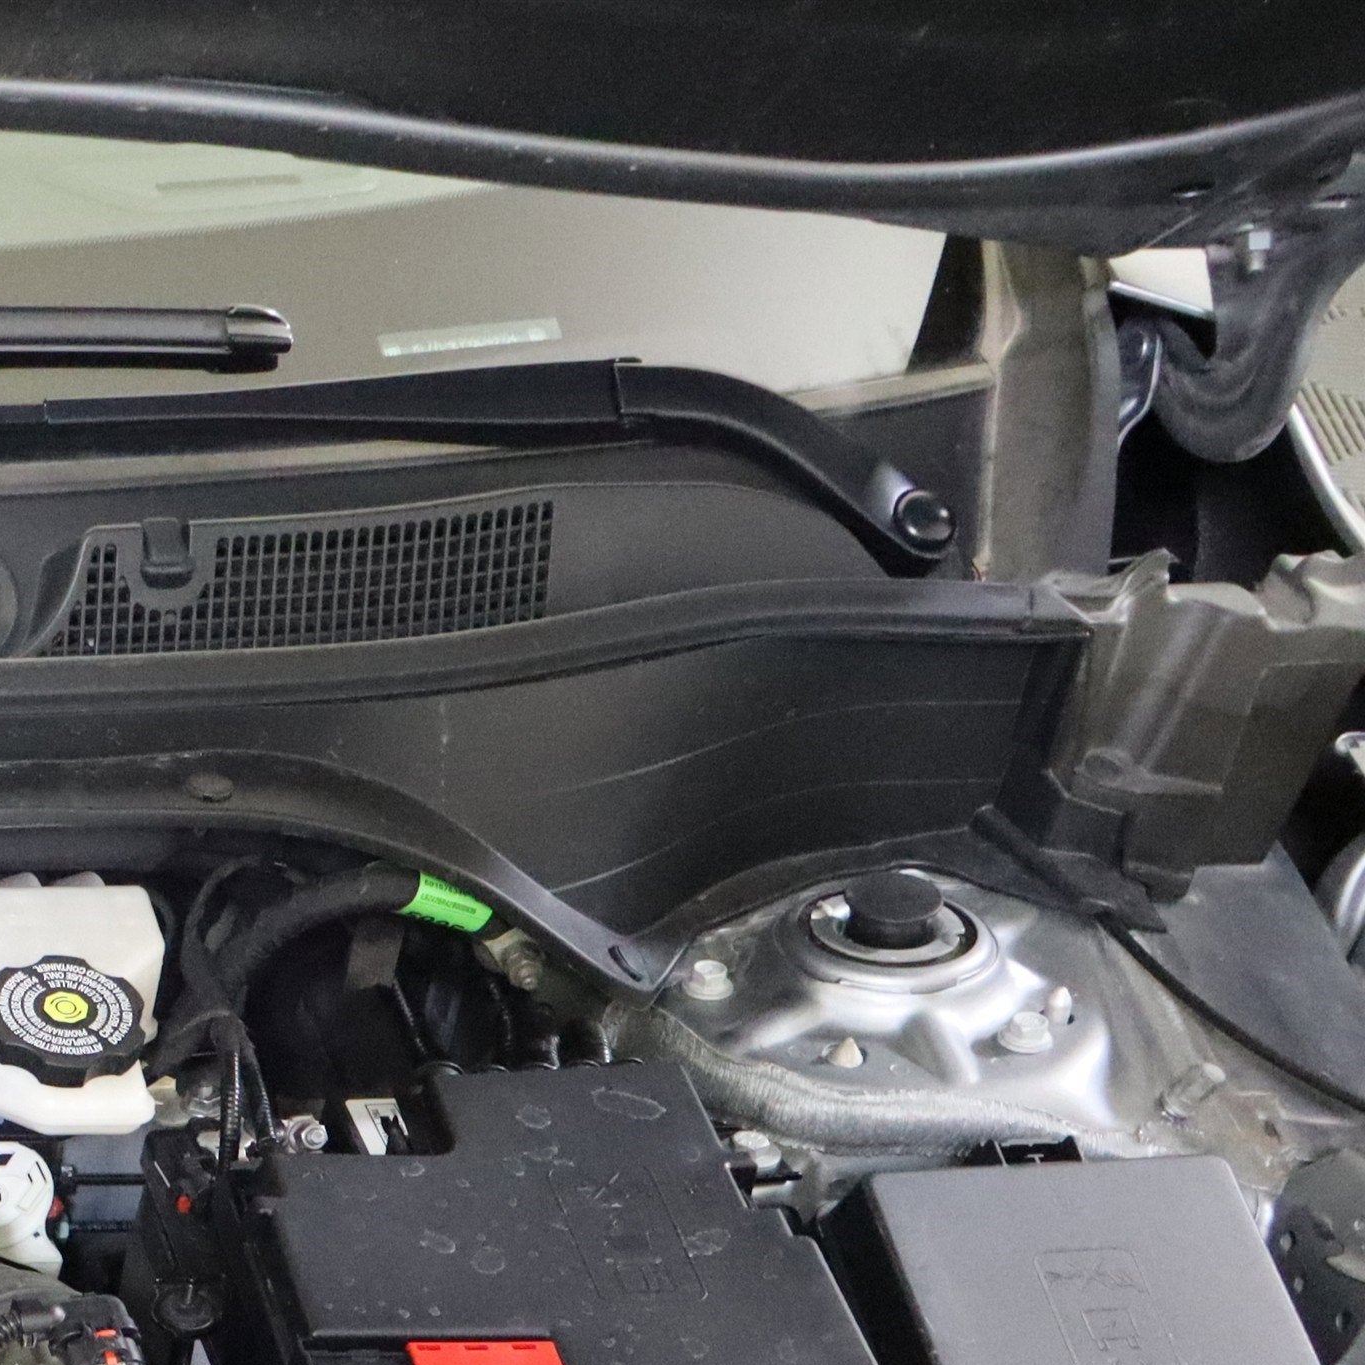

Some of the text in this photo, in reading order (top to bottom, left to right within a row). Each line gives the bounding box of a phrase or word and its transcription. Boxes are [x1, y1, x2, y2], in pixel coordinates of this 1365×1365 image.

[40, 971, 64, 980] ONLY
[85, 969, 118, 990] SEALED
[46, 980, 78, 989] FILLER
[77, 983, 103, 1002] CLEAN
